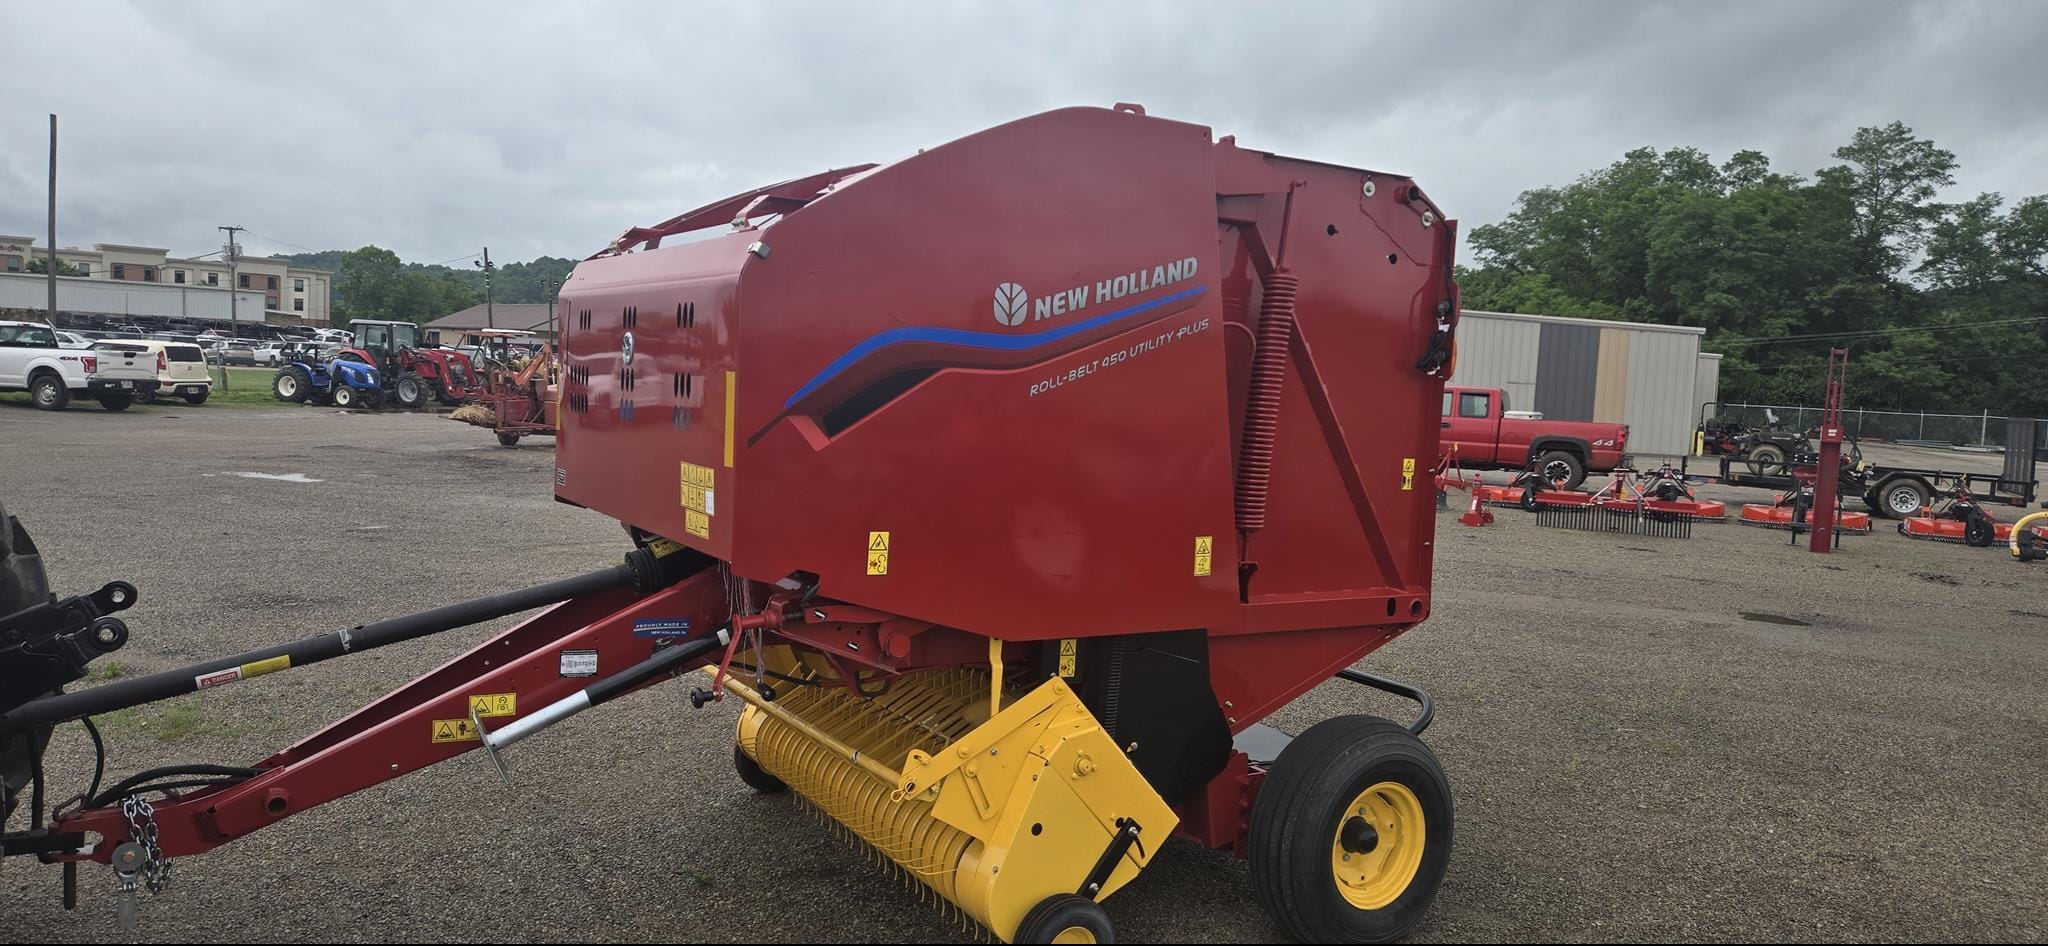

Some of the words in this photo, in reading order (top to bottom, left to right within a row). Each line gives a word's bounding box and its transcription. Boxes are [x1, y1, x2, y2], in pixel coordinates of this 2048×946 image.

[1034, 285, 1090, 322] NEW
[1096, 256, 1198, 304] HOLLAND
[1029, 360, 1100, 397] ROLL-BELT
[1101, 350, 1127, 369] 450
[1129, 331, 1175, 357] UTILITY
[1176, 318, 1210, 341] PLUS
[212, 672, 236, 683] DANGER
